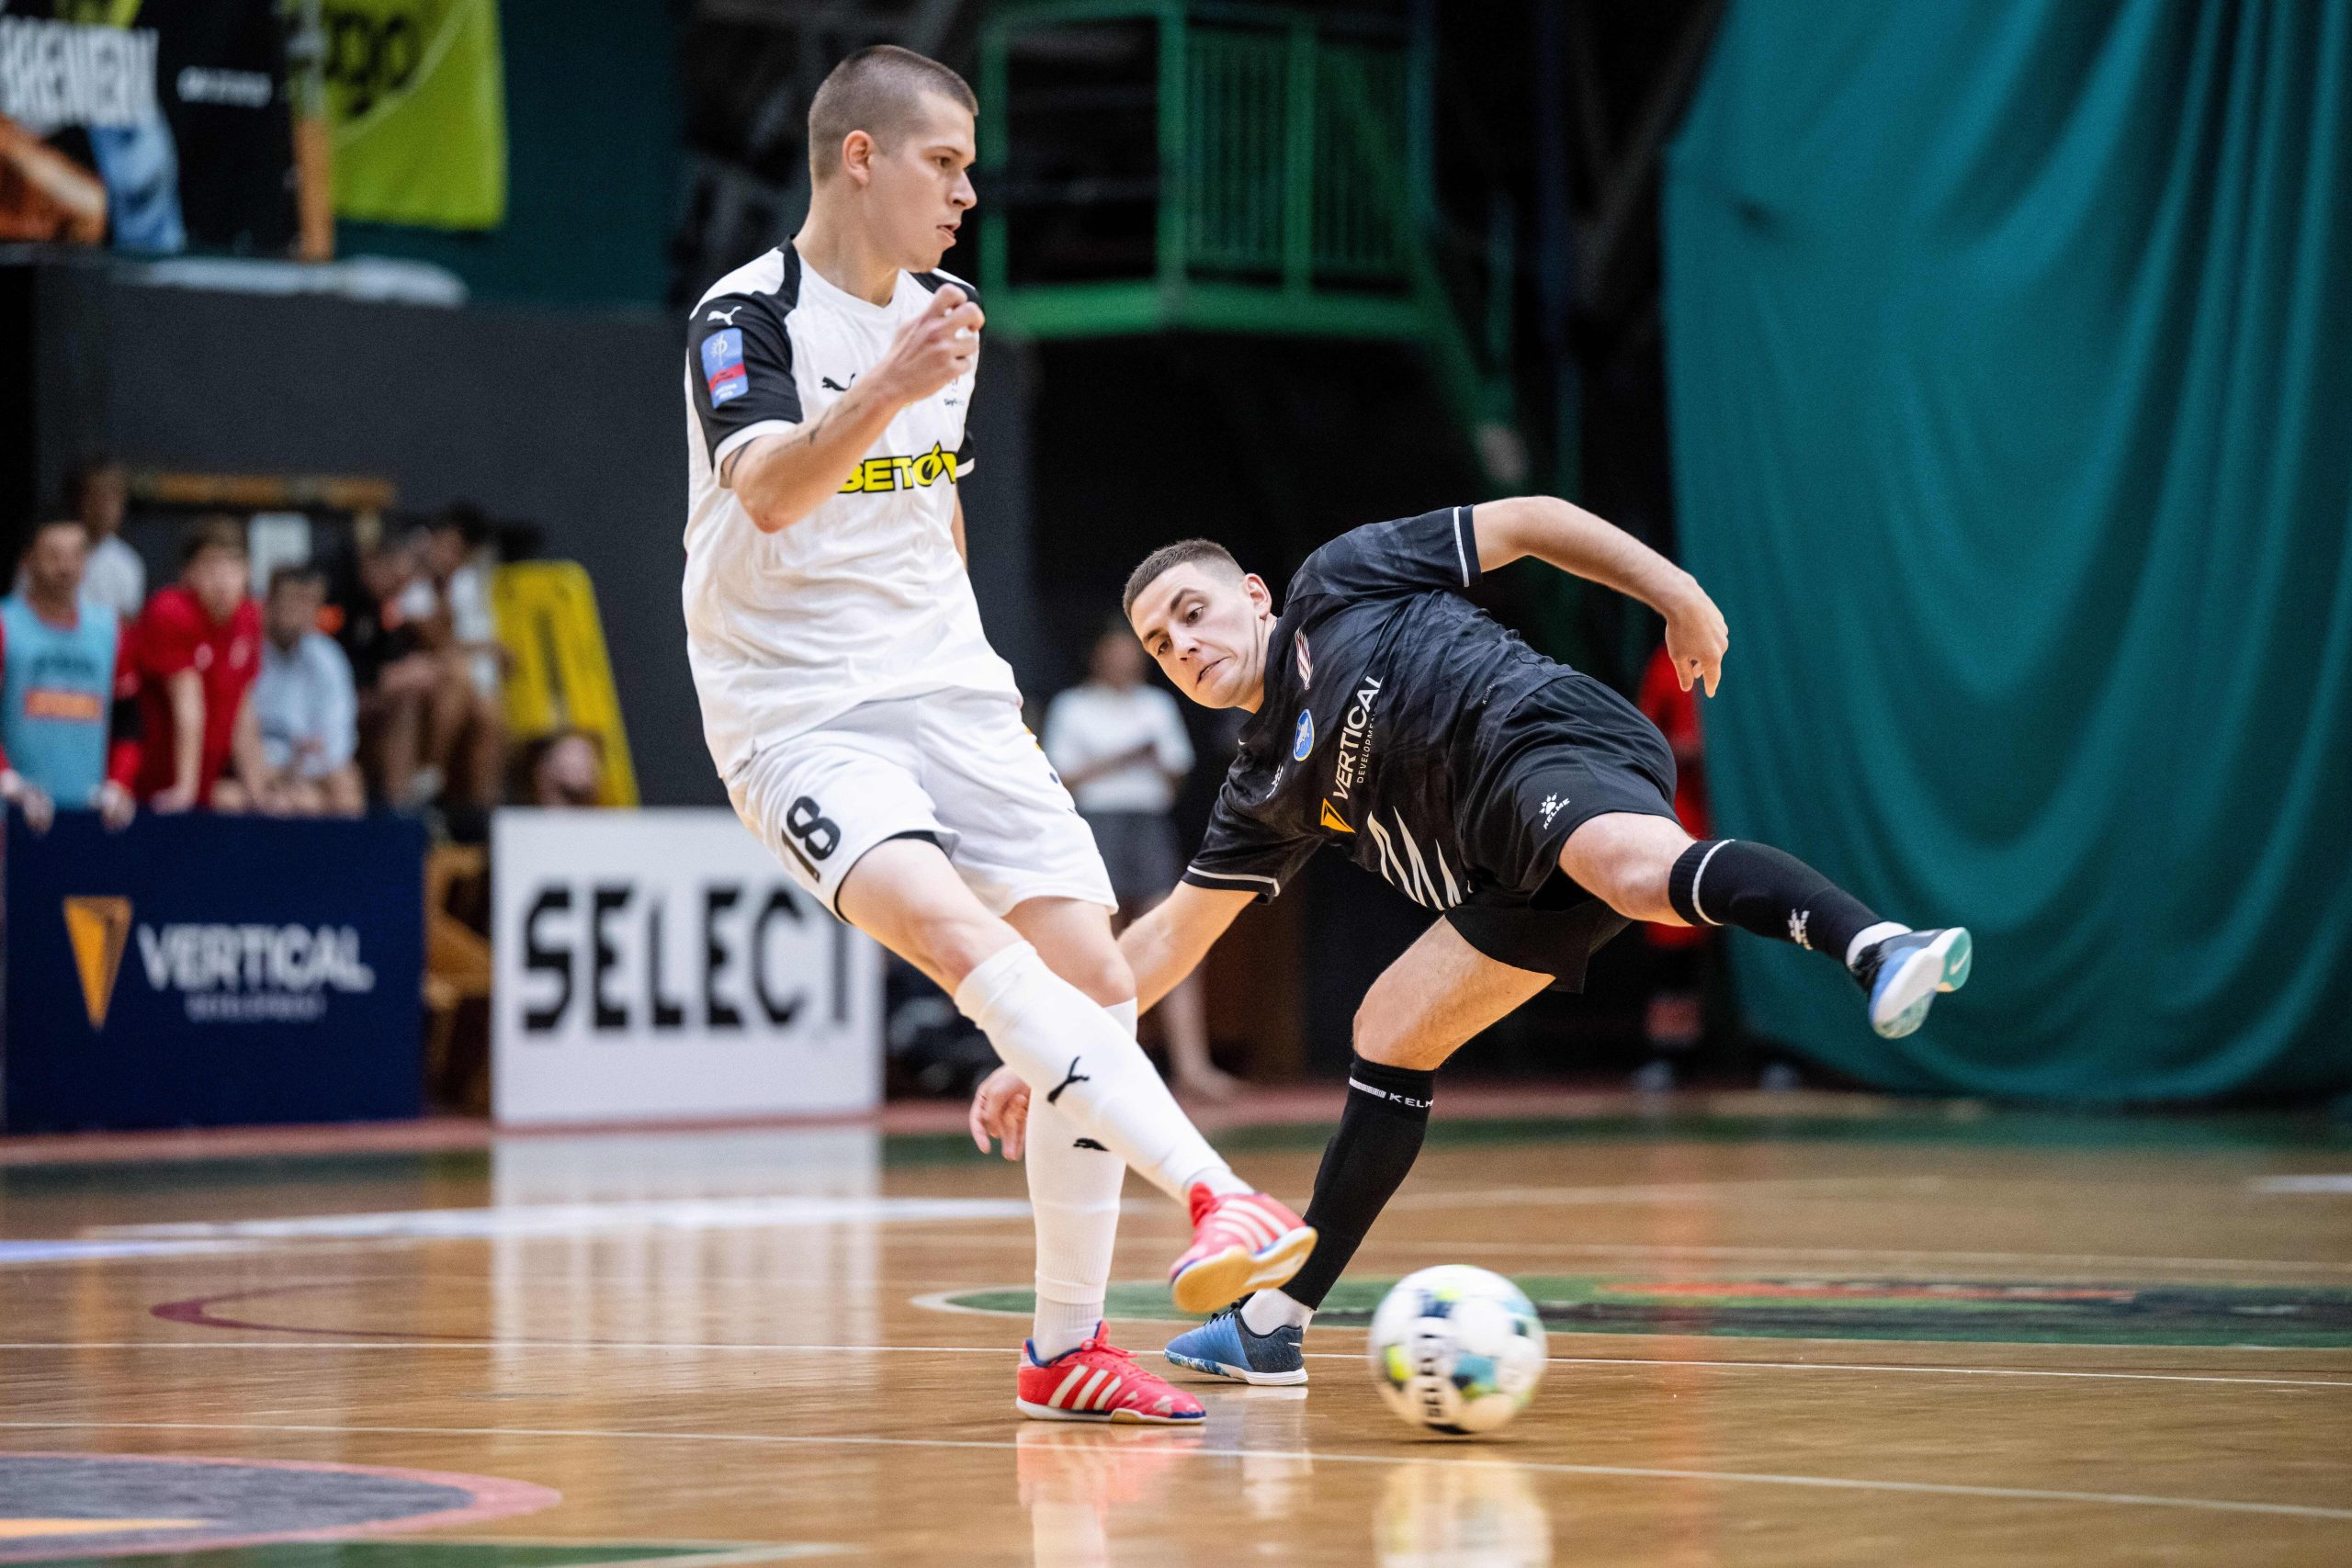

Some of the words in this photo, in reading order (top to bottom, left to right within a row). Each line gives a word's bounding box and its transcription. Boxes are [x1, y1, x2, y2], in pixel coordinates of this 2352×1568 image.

[1332, 675, 1385, 800] VERTICAL
[781, 795, 841, 884] 18
[1544, 797, 1570, 830] KELME
[136, 922, 376, 993] VERTICAL
[1388, 1092, 1434, 1108] KELM
